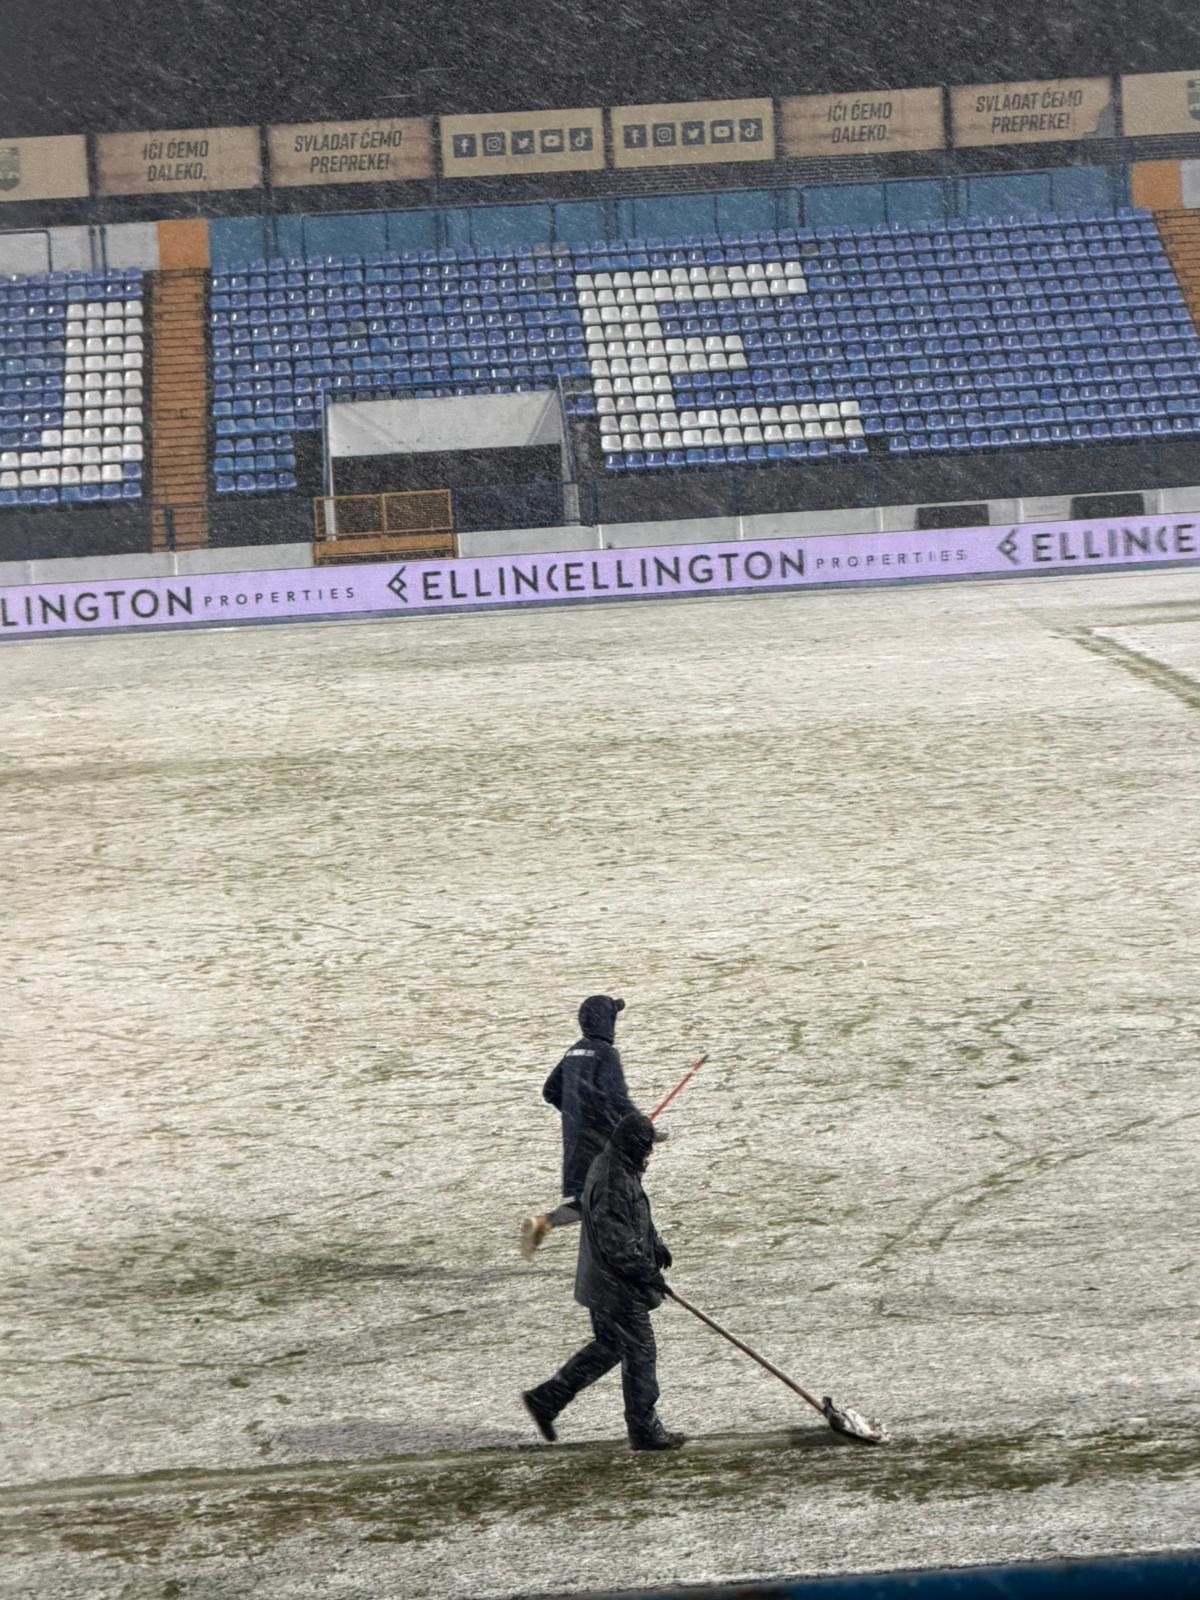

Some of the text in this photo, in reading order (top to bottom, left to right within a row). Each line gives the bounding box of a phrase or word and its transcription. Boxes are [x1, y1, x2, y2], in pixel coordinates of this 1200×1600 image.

[850, 99, 893, 121] ĆEMO
[976, 86, 1083, 113] SVLADAT ĆEMO
[991, 112, 1070, 133] PREPREKE!
[167, 138, 209, 159] ĆEMO
[294, 127, 402, 153] SVLADAT ĆEMO
[310, 153, 390, 173] PREPREKE!
[564, 548, 805, 592] ELLINGTON
[816, 548, 967, 569] PROPERTIES
[0, 586, 355, 627] LINGTON PROPERTIES
